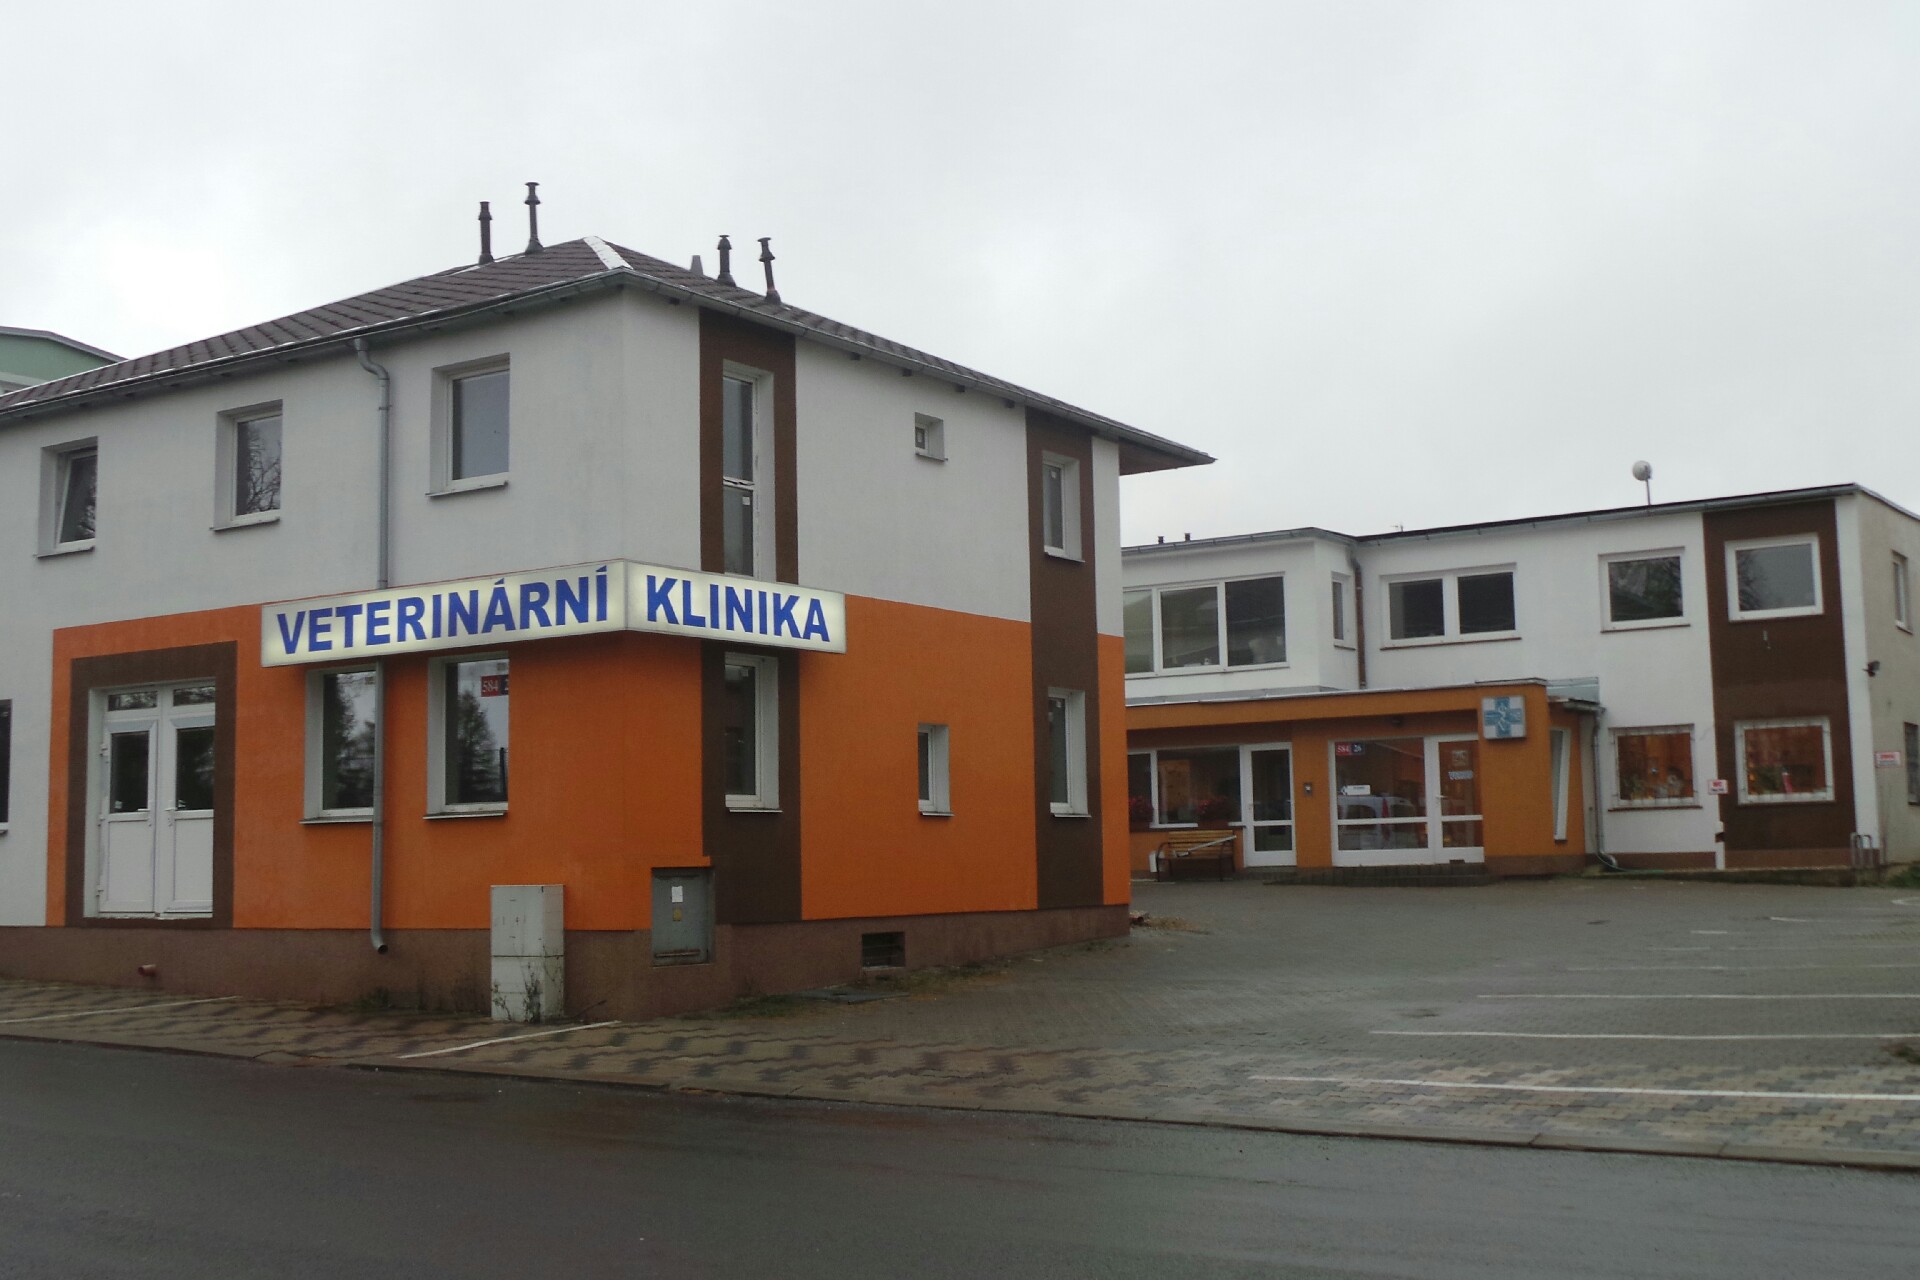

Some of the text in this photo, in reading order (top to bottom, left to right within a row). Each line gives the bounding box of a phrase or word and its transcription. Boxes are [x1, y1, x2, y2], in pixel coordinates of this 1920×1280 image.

[277, 566, 831, 654] VETERINÁRNÍ KLINIKA
[482, 679, 499, 694] 584
